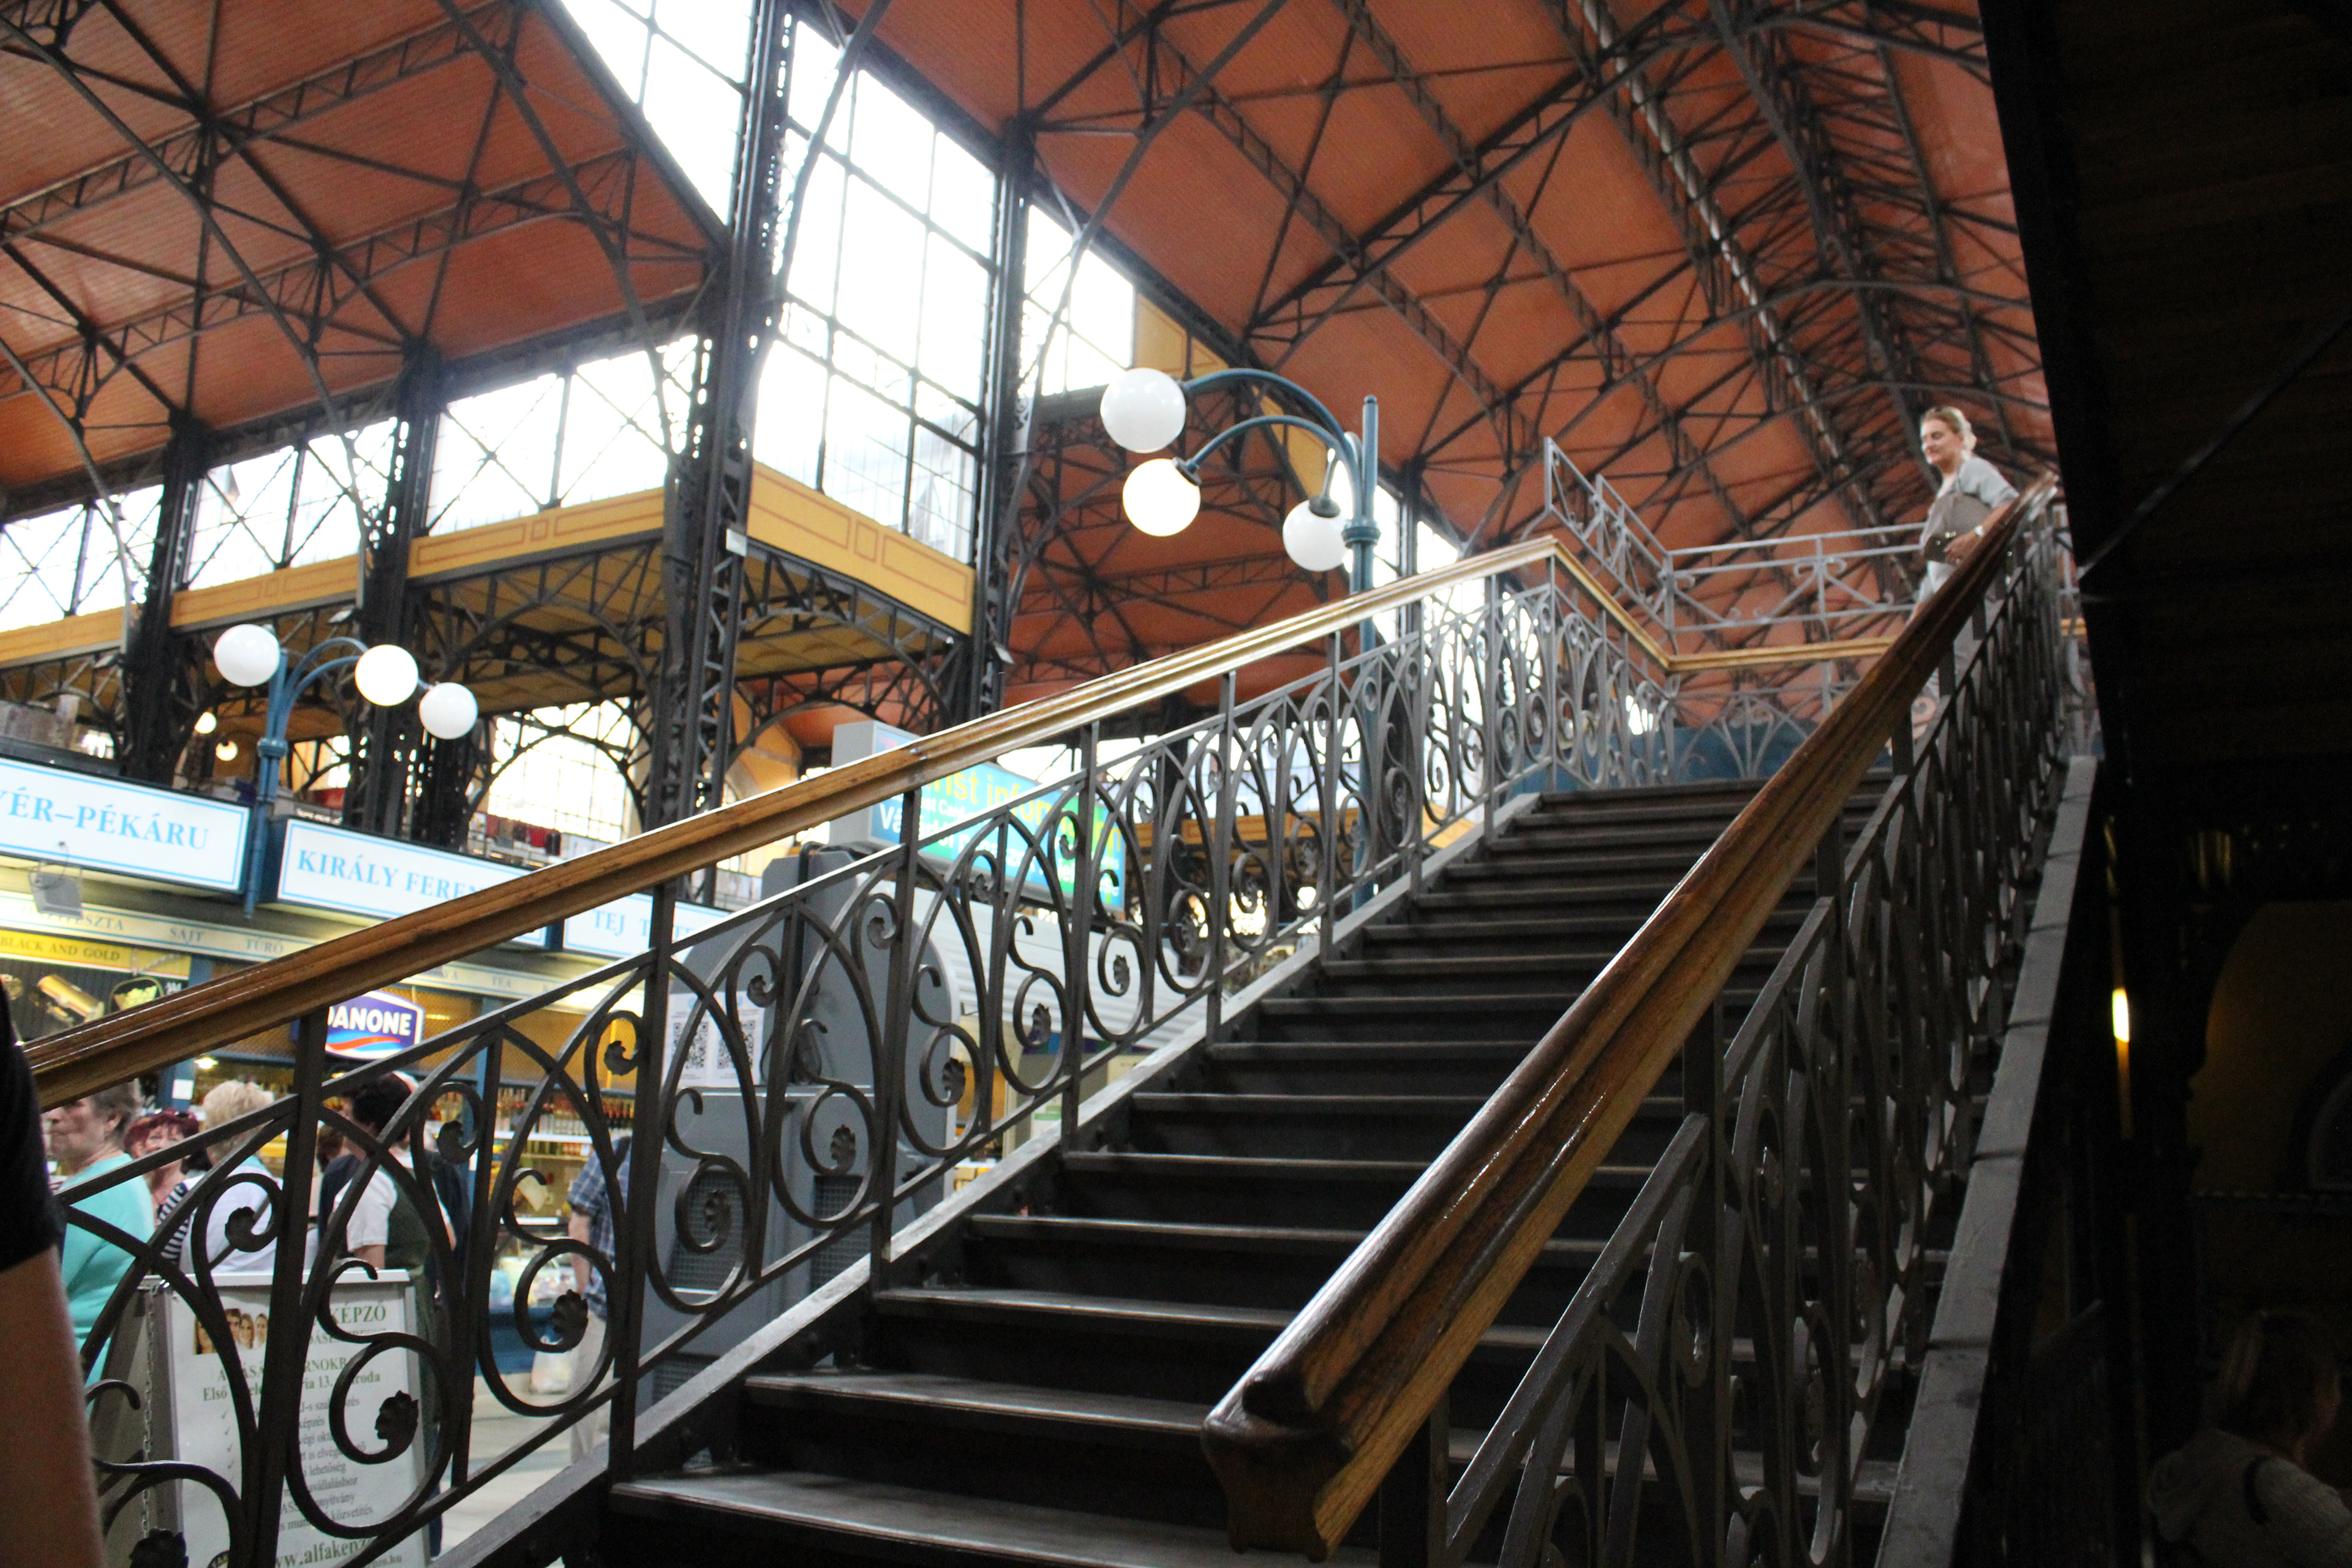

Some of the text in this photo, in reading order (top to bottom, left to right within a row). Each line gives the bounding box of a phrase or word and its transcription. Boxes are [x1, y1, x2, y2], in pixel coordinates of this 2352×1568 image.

[0, 786, 209, 850] ÉR–PÉKÁRU
[296, 849, 398, 888] KIRÁLY
[169, 926, 206, 944] SAJT
[592, 910, 625, 937] TEJ
[1, 936, 119, 962] BLACK AND GOLD
[203, 1385, 228, 1401] Első
